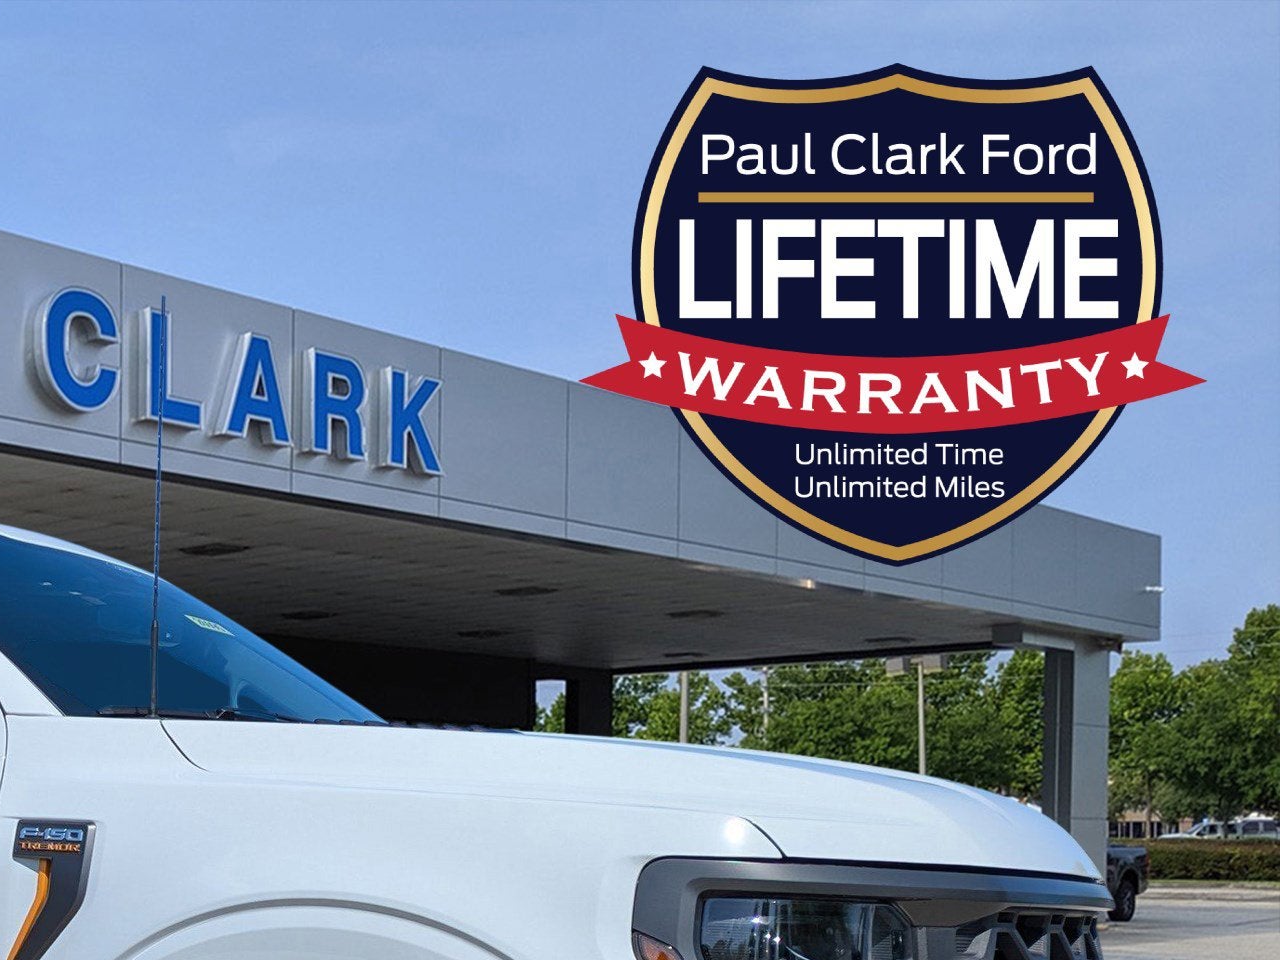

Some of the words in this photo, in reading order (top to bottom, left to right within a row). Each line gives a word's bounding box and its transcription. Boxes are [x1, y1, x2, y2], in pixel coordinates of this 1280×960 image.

[33, 285, 443, 477] CLARK
[19, 826, 84, 841] F-150
[19, 841, 81, 853] TREMOR
